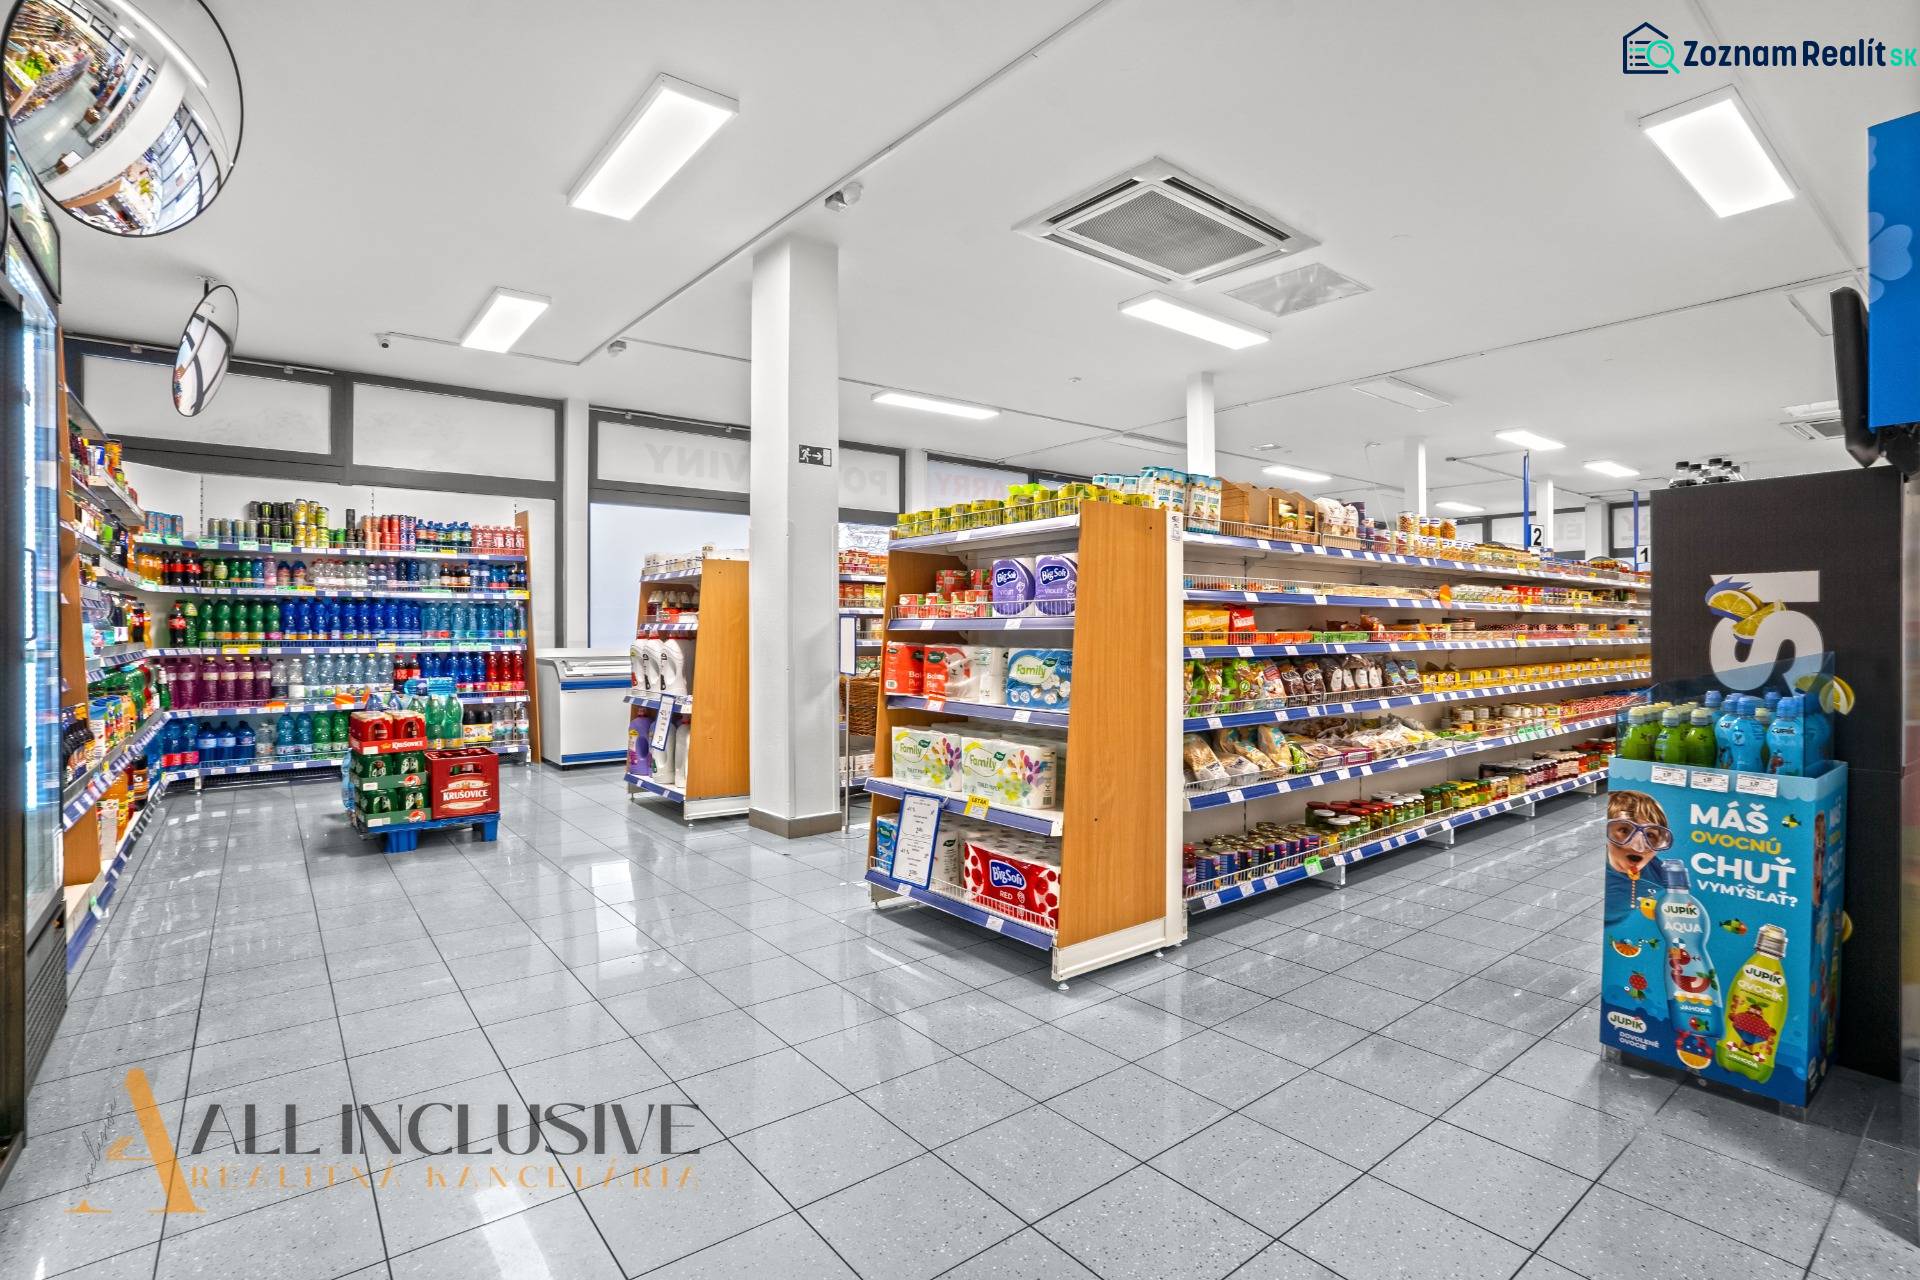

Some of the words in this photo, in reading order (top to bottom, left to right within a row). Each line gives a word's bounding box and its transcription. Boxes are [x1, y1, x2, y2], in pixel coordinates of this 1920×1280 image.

[1533, 527, 1542, 546] 2
[1640, 547, 1649, 562] 1
[1016, 664, 1046, 678] Family
[899, 743, 922, 757] Family
[970, 754, 997, 771] Family
[442, 789, 489, 801] KRUŠOVICE
[1690, 801, 1769, 834] MÁŠ
[1691, 831, 1782, 855] OVOCNÚ
[1690, 853, 1797, 889] CHUŤ
[999, 890, 1013, 900] RED
[1664, 920, 1705, 933] AQUA
